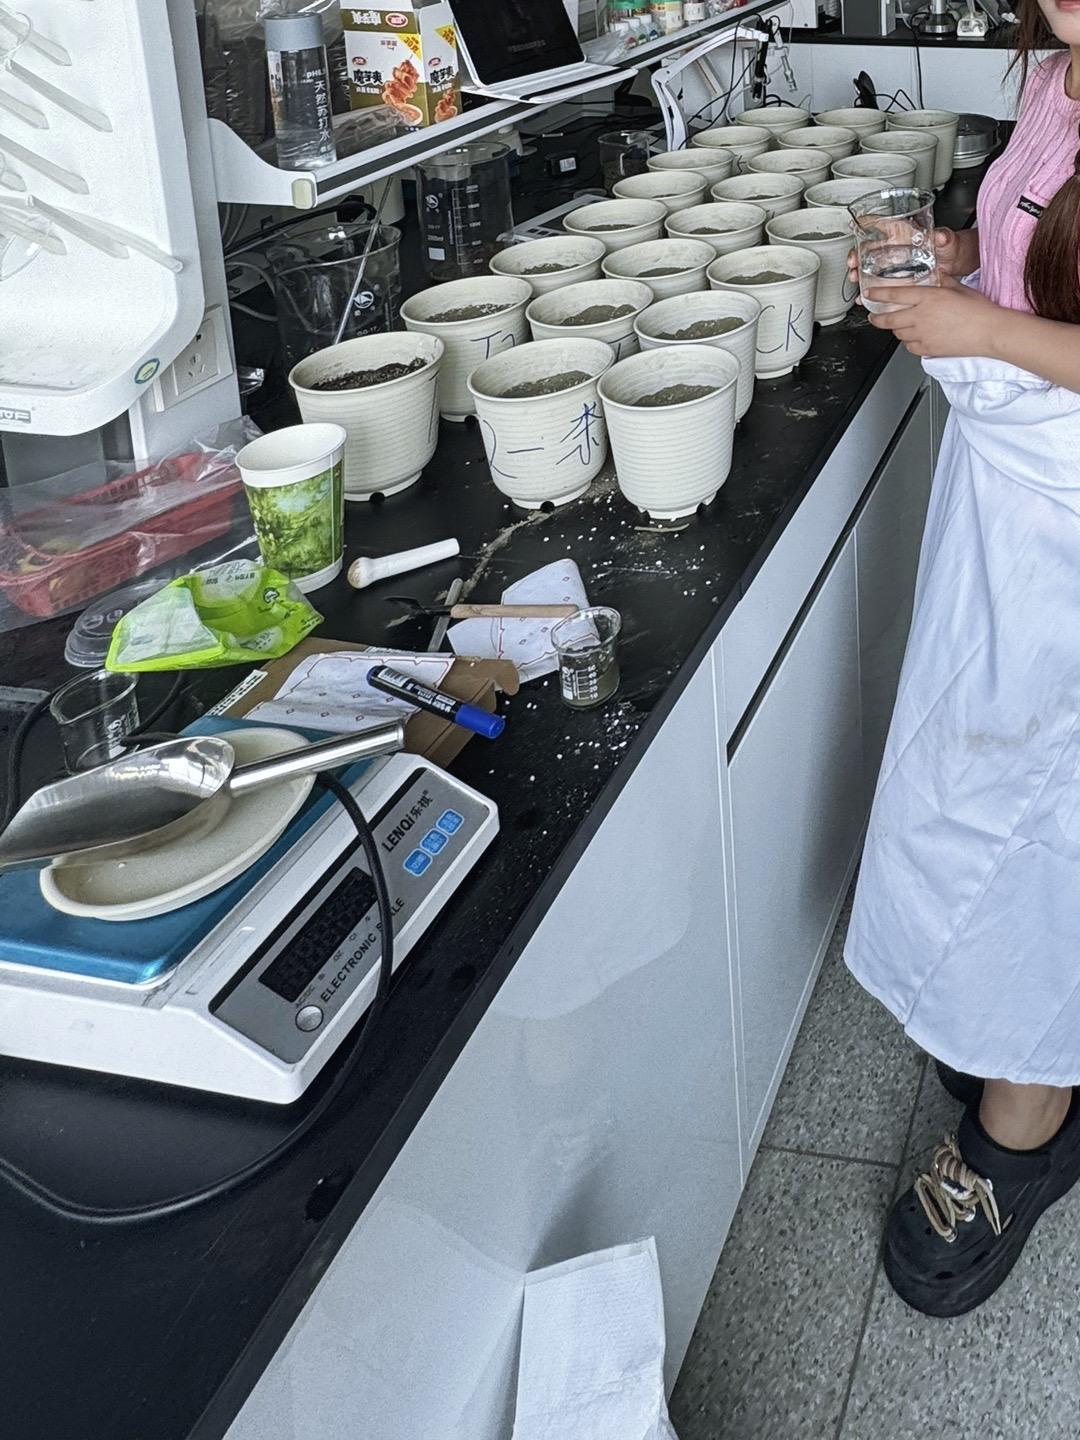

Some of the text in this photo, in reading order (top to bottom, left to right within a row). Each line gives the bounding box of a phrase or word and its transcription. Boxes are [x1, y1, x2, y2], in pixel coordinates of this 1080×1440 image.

[314, 80, 332, 142] 天然苏打水
[755, 303, 806, 355] CK
[382, 814, 415, 852] LENQi
[320, 932, 378, 1002] ELECTRONIC
